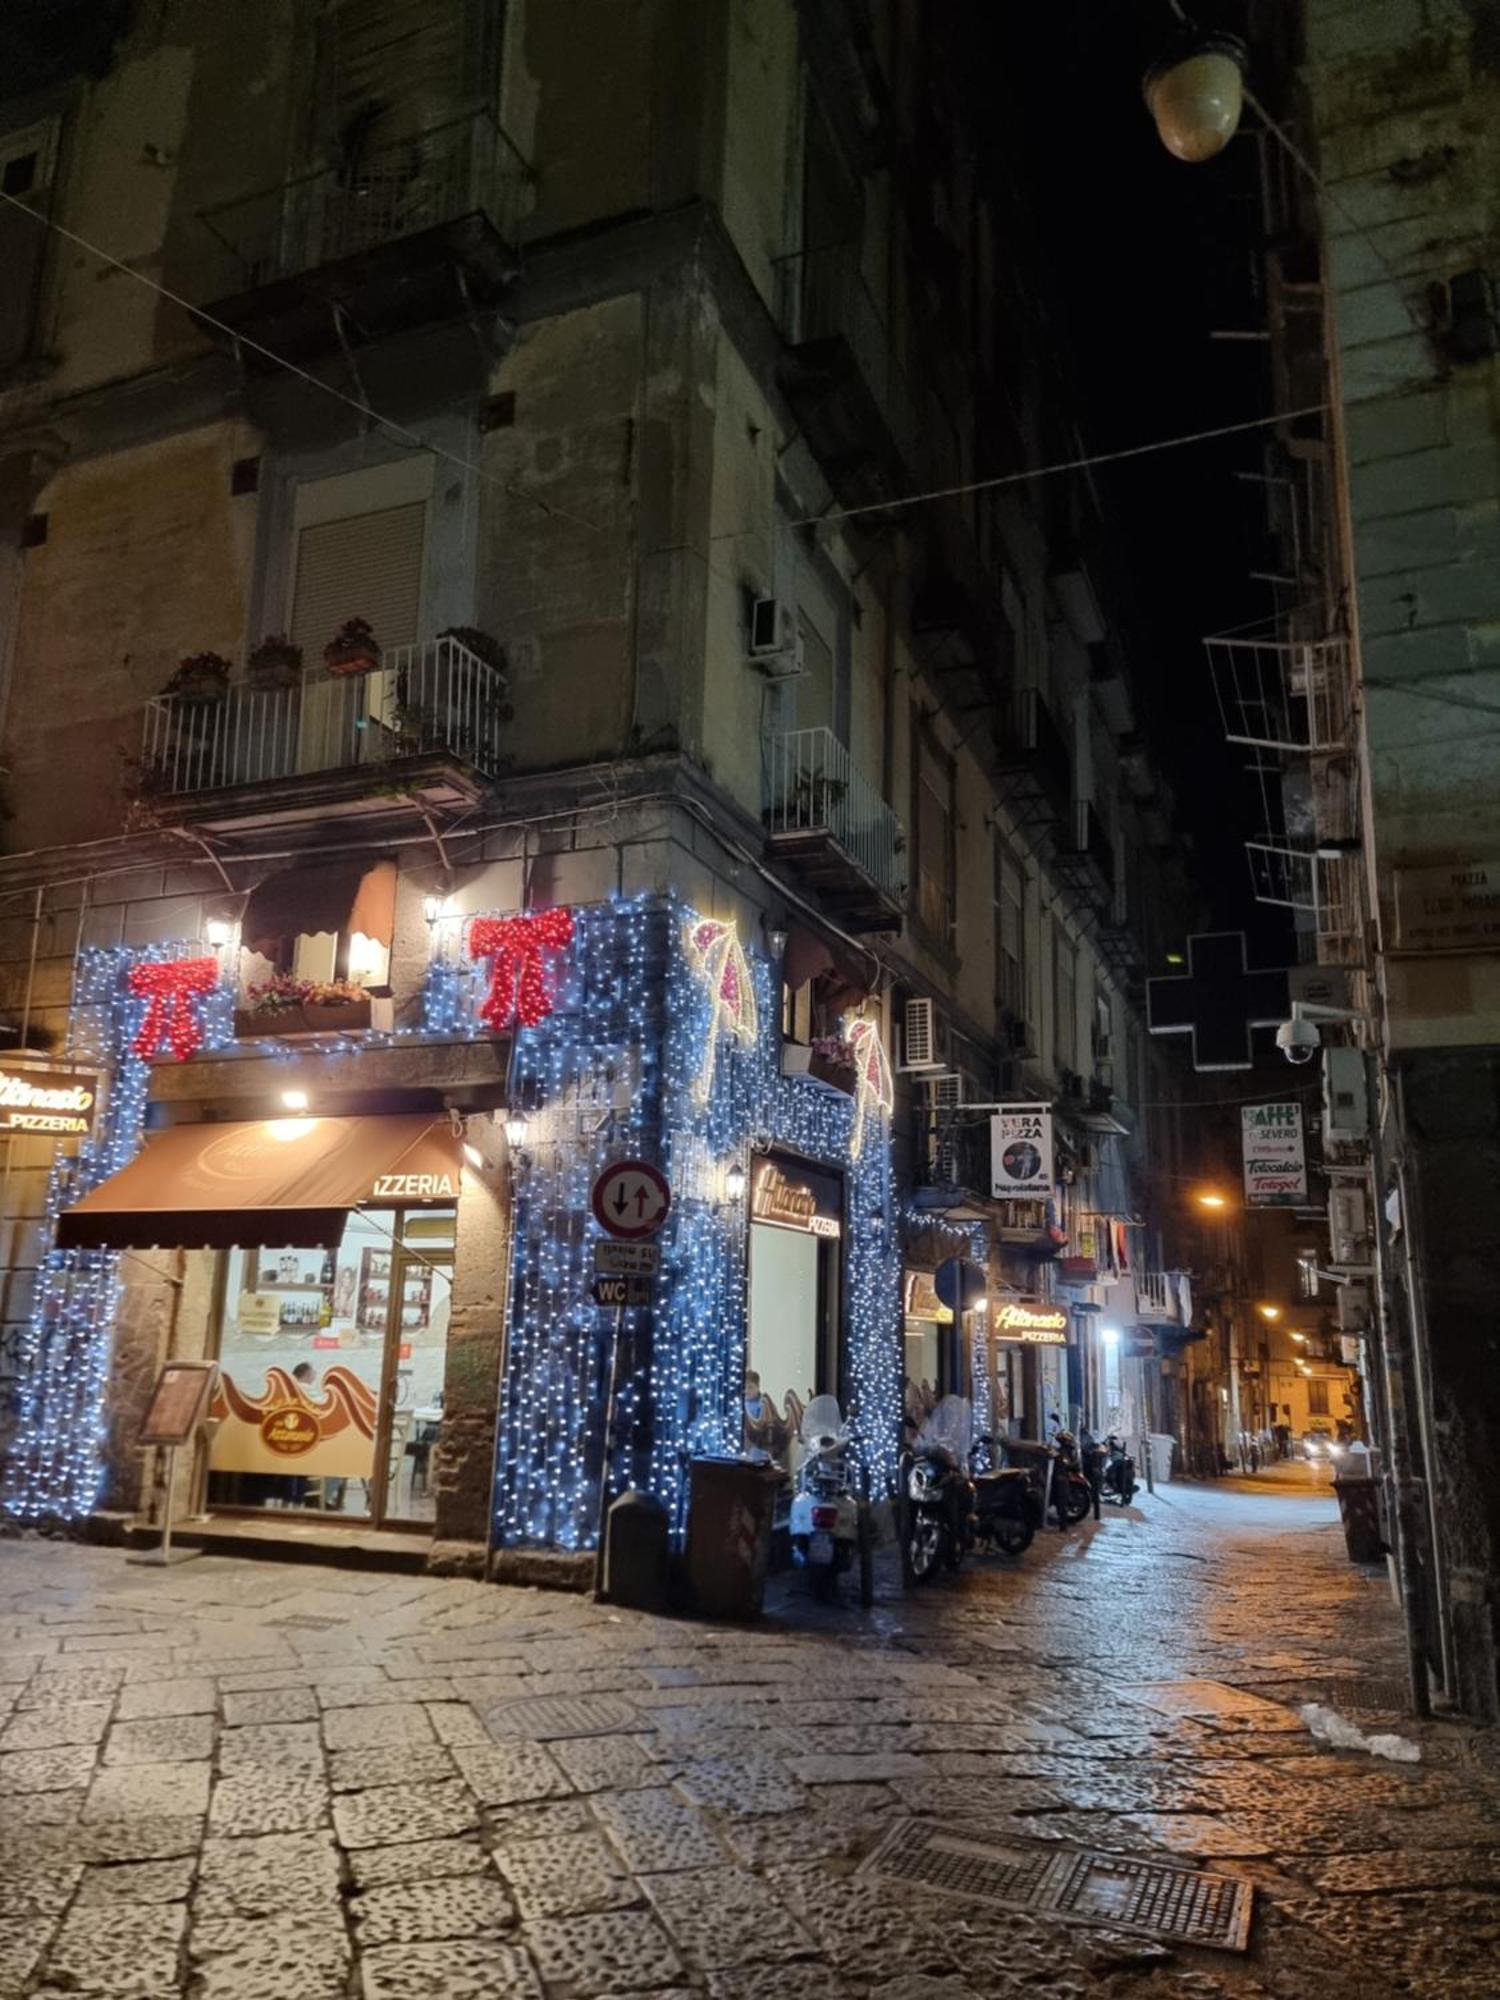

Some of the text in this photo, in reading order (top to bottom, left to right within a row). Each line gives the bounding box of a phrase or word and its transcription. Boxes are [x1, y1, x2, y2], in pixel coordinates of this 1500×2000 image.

[10, 1113, 89, 1132] PIZZERIA
[1001, 1117, 1042, 1128] VERA
[1002, 1128, 1042, 1140] PIZZA
[1260, 1128, 1297, 1140] SEVERO
[1246, 1159, 1304, 1175] Totocalcio
[598, 1281, 626, 1301] WC
[995, 1304, 1066, 1329] Attanasio
[1021, 1331, 1067, 1343] PIZZERIA
